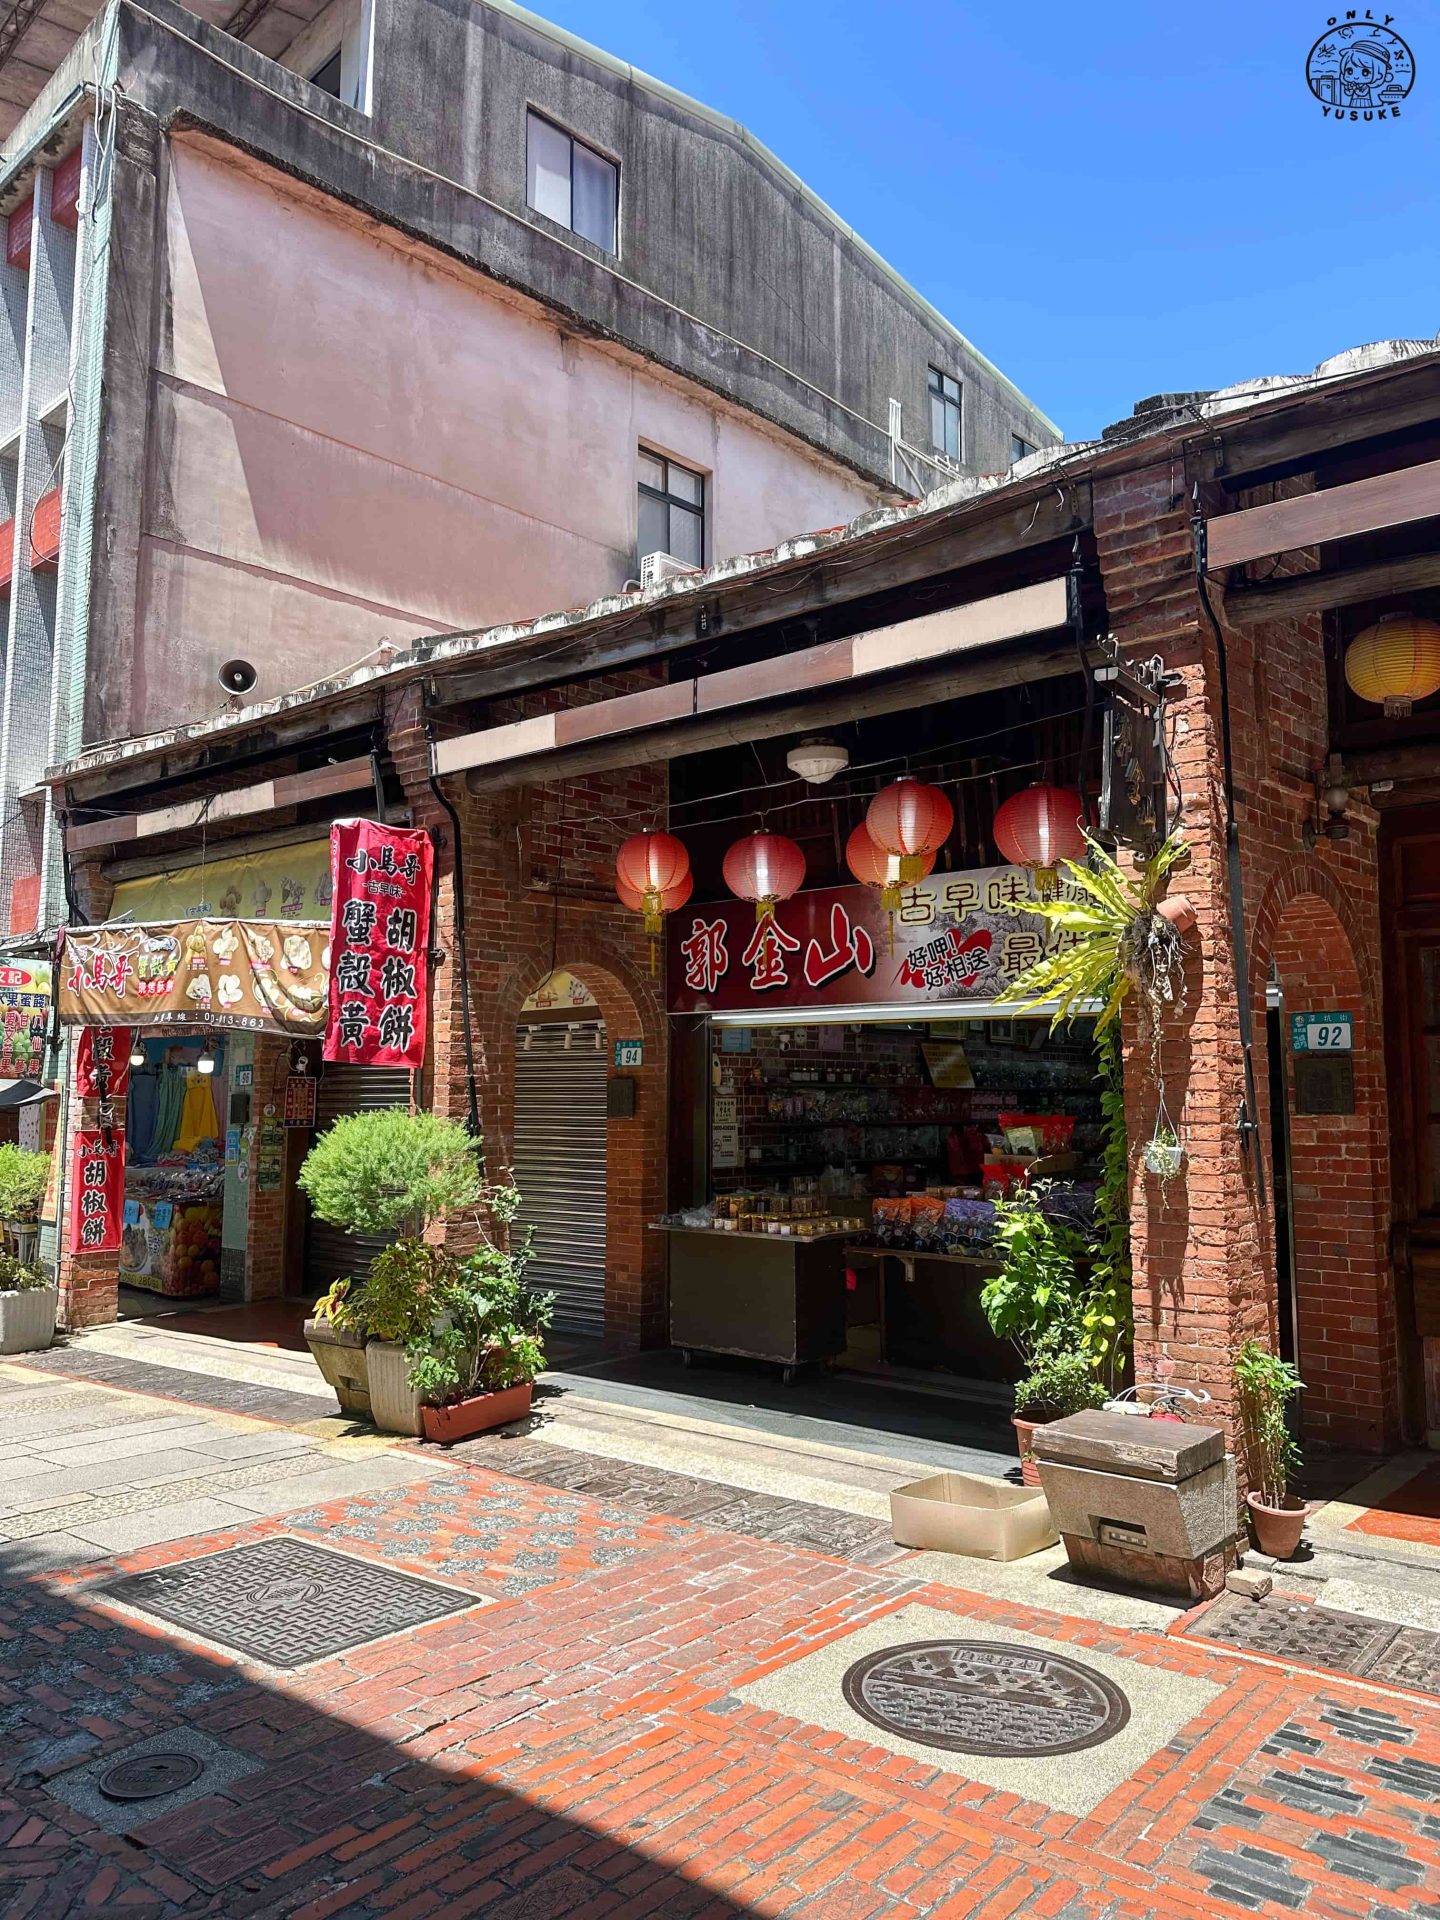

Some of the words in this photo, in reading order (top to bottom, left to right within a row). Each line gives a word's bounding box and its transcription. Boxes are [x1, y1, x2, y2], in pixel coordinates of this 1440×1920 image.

[346, 845, 421, 886] 小馬哥
[682, 903, 873, 992] 郭金山
[924, 947, 991, 990] 好相送
[68, 950, 133, 998] 小馬哥
[336, 899, 377, 1048] 蟹殼黃
[379, 907, 417, 1054] 胡椒餅
[625, 1049, 638, 1064] 94
[1317, 1026, 1342, 1047] 92
[82, 1160, 107, 1245] 胡椒餅
